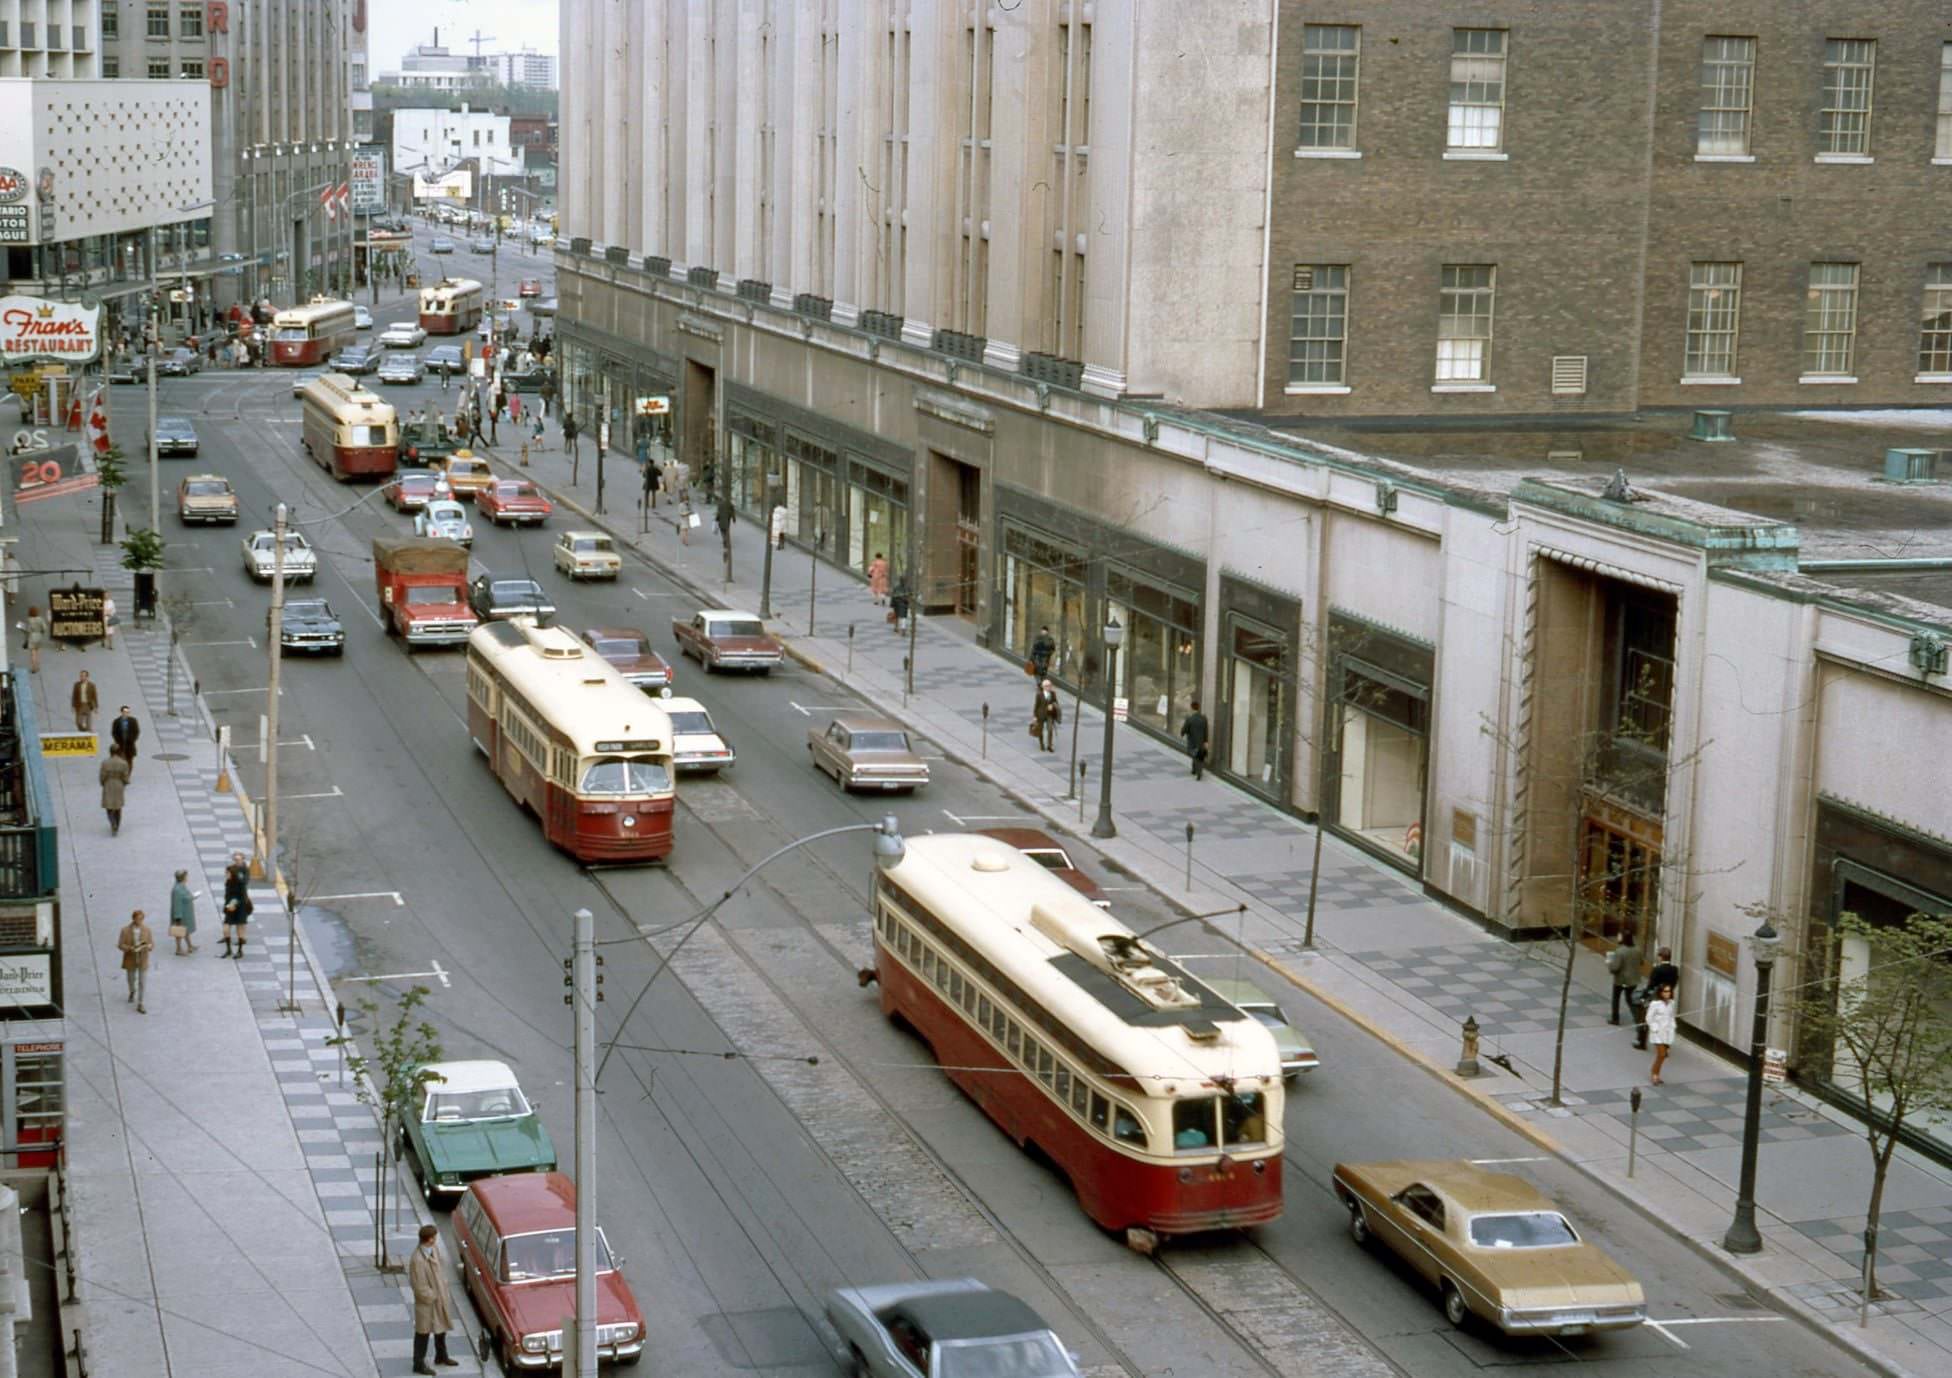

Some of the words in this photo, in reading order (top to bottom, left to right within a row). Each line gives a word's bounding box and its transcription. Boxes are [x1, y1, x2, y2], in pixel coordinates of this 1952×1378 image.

[3, 308, 90, 337] Fran's
[5, 339, 93, 353] RESTAURANT
[21, 461, 61, 485] 20
[53, 621, 103, 636] AUCTIONEERS
[16, 1043, 63, 1052] TELEPHONE
